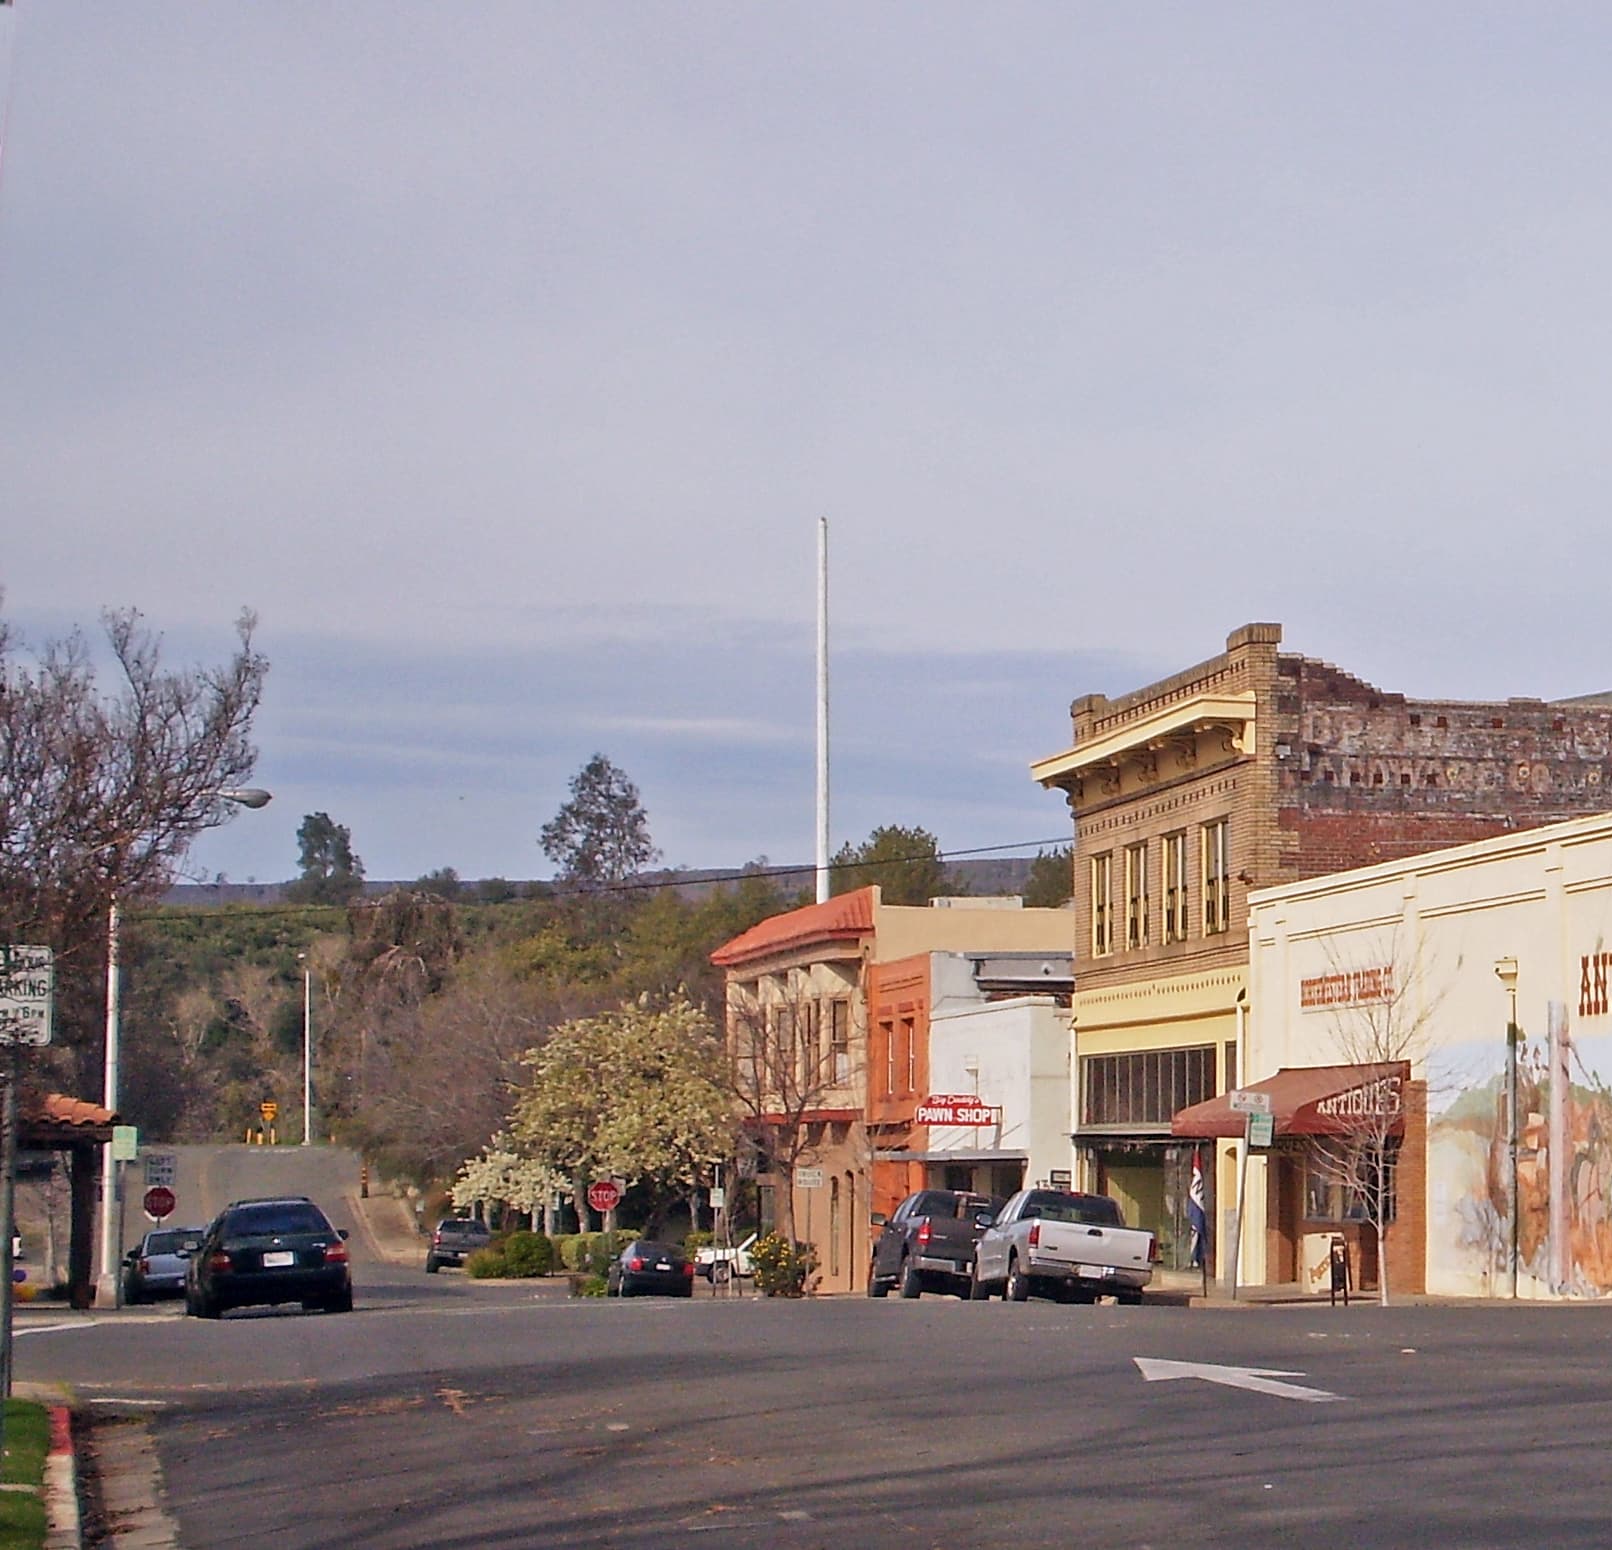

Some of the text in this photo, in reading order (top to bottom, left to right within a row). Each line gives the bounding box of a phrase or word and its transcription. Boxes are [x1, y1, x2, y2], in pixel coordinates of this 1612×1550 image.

[1316, 1076, 1401, 1116] ANTIQUES
[918, 1107, 990, 1122] PAWN SHOP
[590, 1190, 617, 1202] STOP
